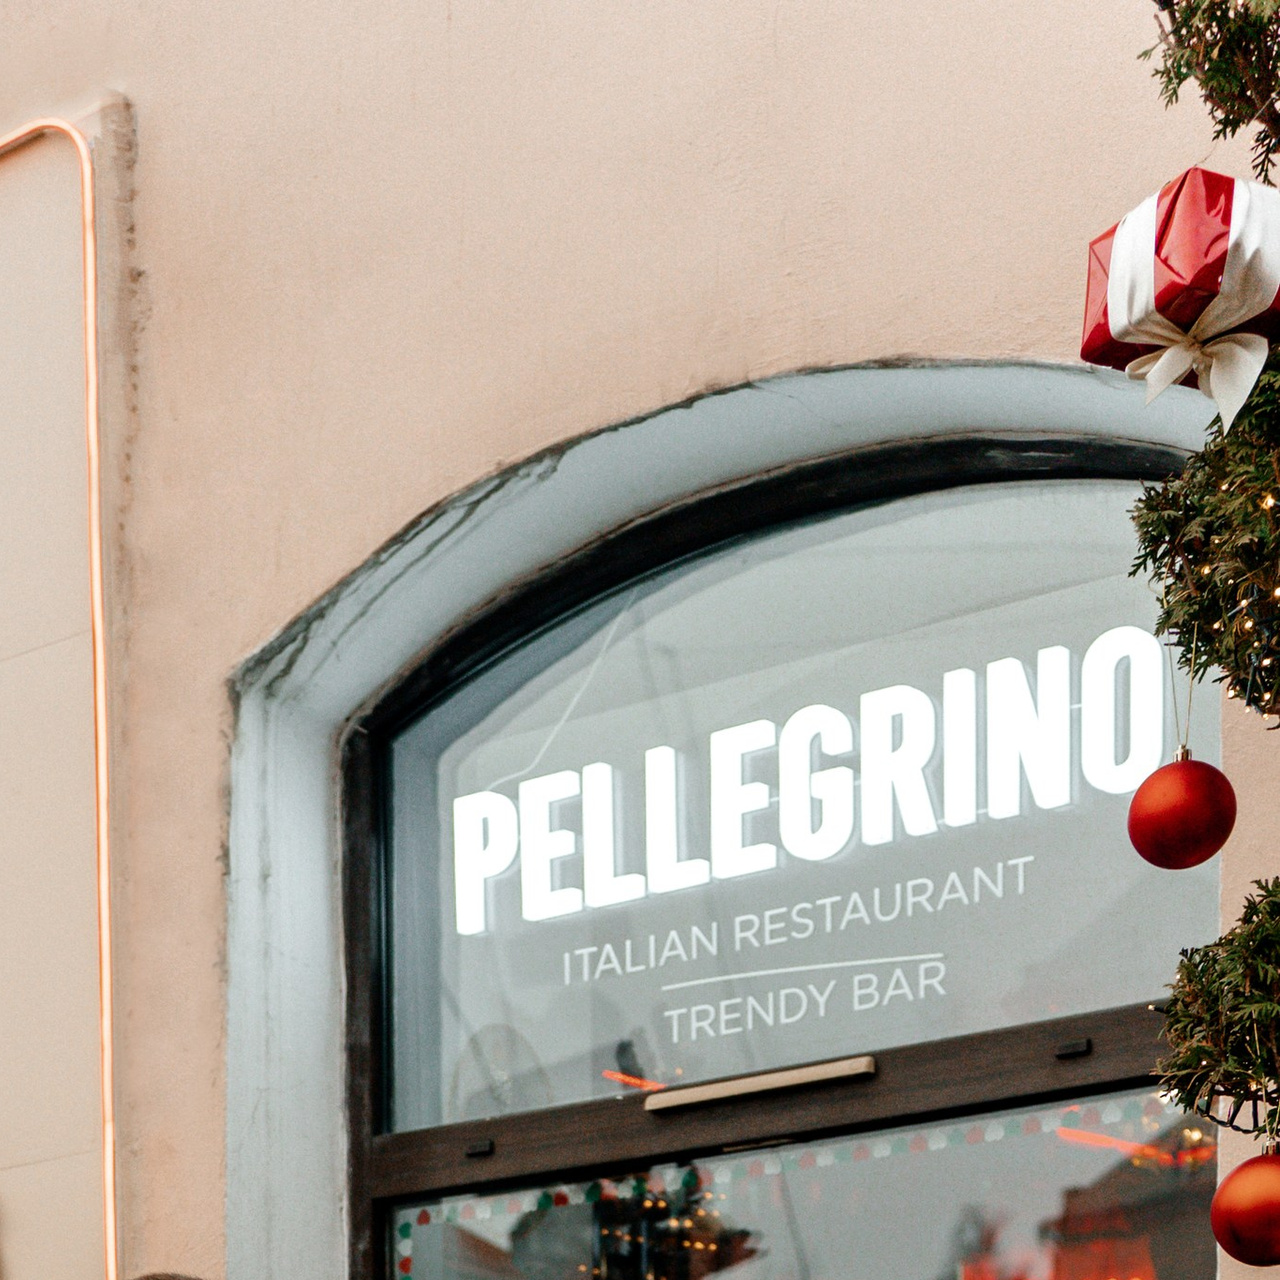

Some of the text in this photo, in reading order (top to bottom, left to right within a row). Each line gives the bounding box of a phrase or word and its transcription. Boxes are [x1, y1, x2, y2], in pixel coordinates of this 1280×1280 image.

[453, 625, 1164, 936] PELLEGRINO
[563, 855, 1035, 986] ITALIAN RESTAURANT
[664, 961, 947, 1044] TRENDY BAR
